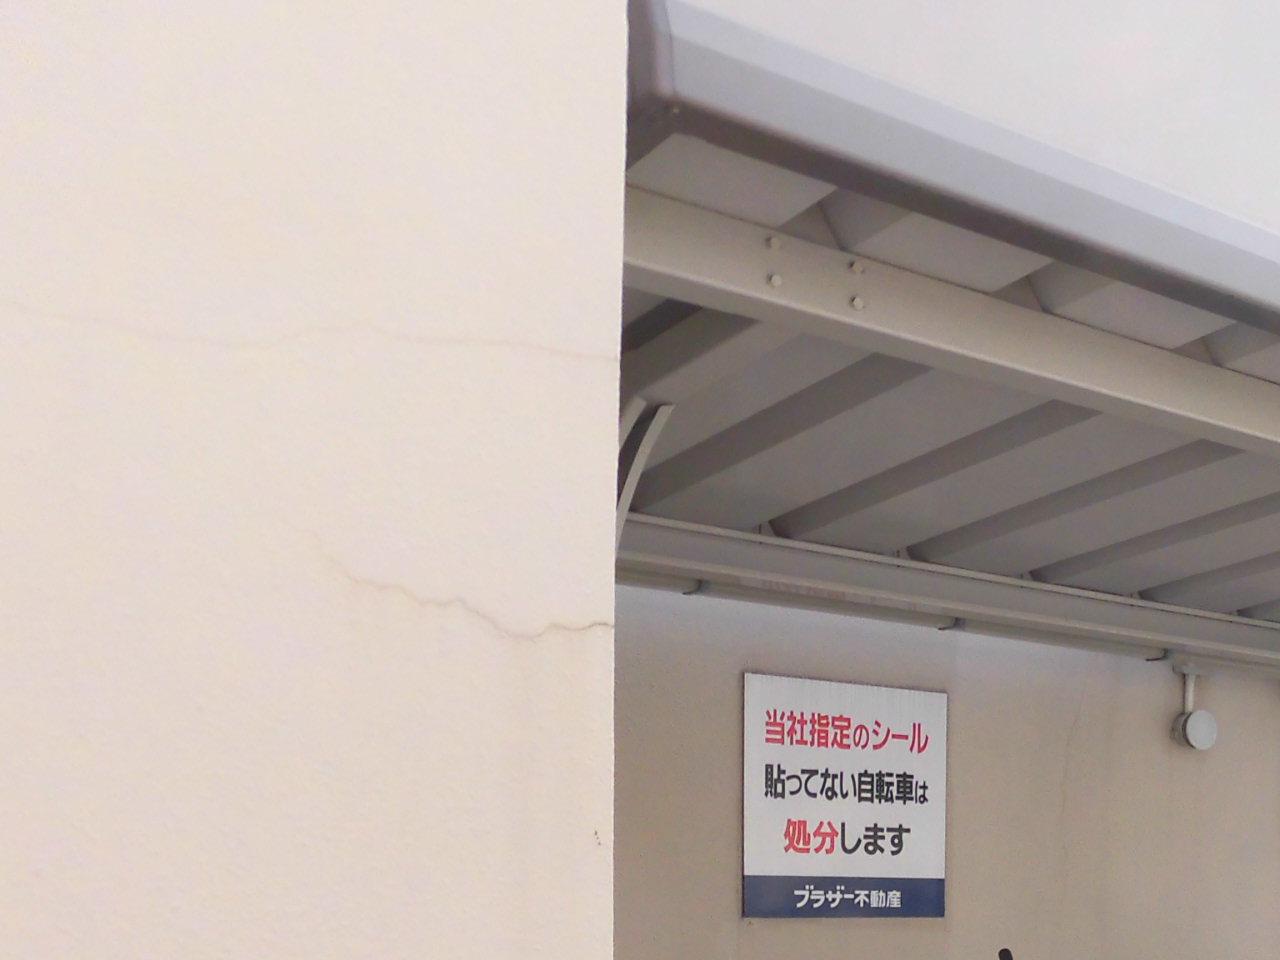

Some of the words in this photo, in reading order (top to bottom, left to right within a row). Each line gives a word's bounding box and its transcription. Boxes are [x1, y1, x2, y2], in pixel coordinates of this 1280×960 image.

[764, 708, 929, 754] 当社指定のシール
[763, 763, 929, 805] 貼ってない自転車は
[784, 818, 911, 856] 処分します
[793, 884, 902, 909] ブラザー不動産
